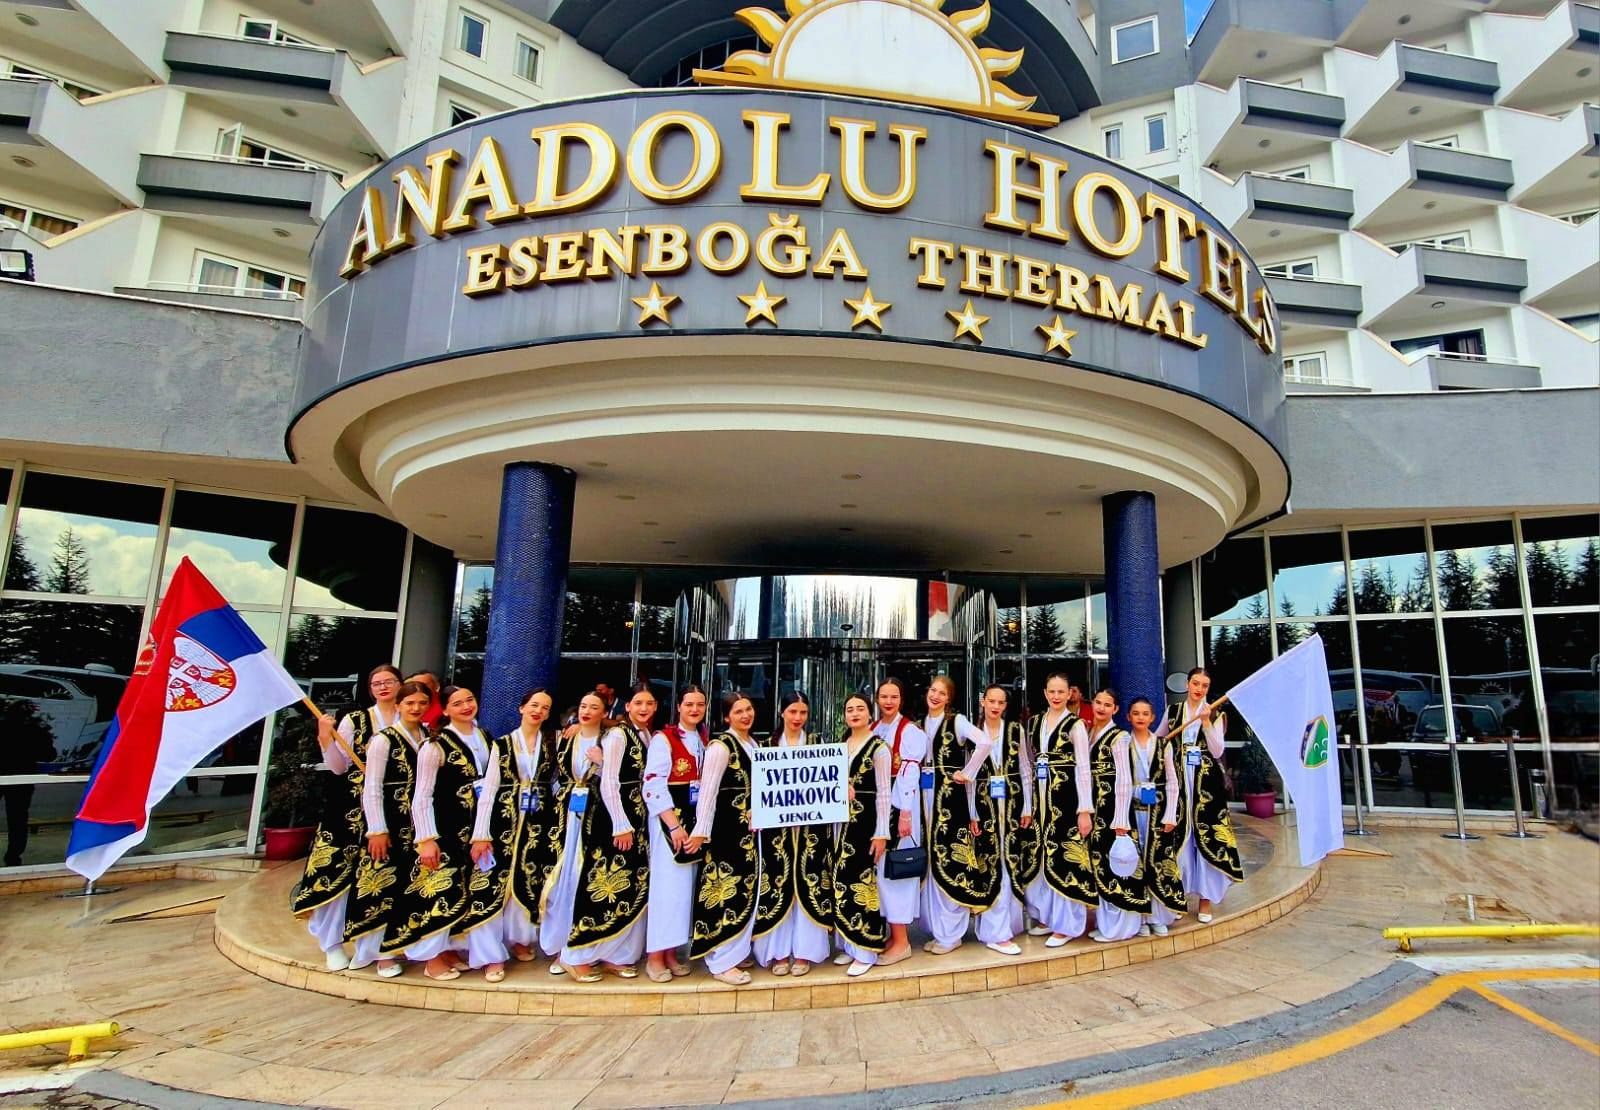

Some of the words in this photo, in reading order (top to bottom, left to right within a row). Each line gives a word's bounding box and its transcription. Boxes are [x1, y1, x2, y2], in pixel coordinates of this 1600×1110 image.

[339, 109, 928, 281] ANADOLU
[982, 139, 1278, 356] HOTELS
[462, 213, 869, 299] ESENBOĞA
[909, 236, 1208, 350] THERMAL
[754, 750, 788, 762] ŠKOLA
[792, 747, 843, 760] FOLKLORA
[779, 811, 823, 824] SJENICA
